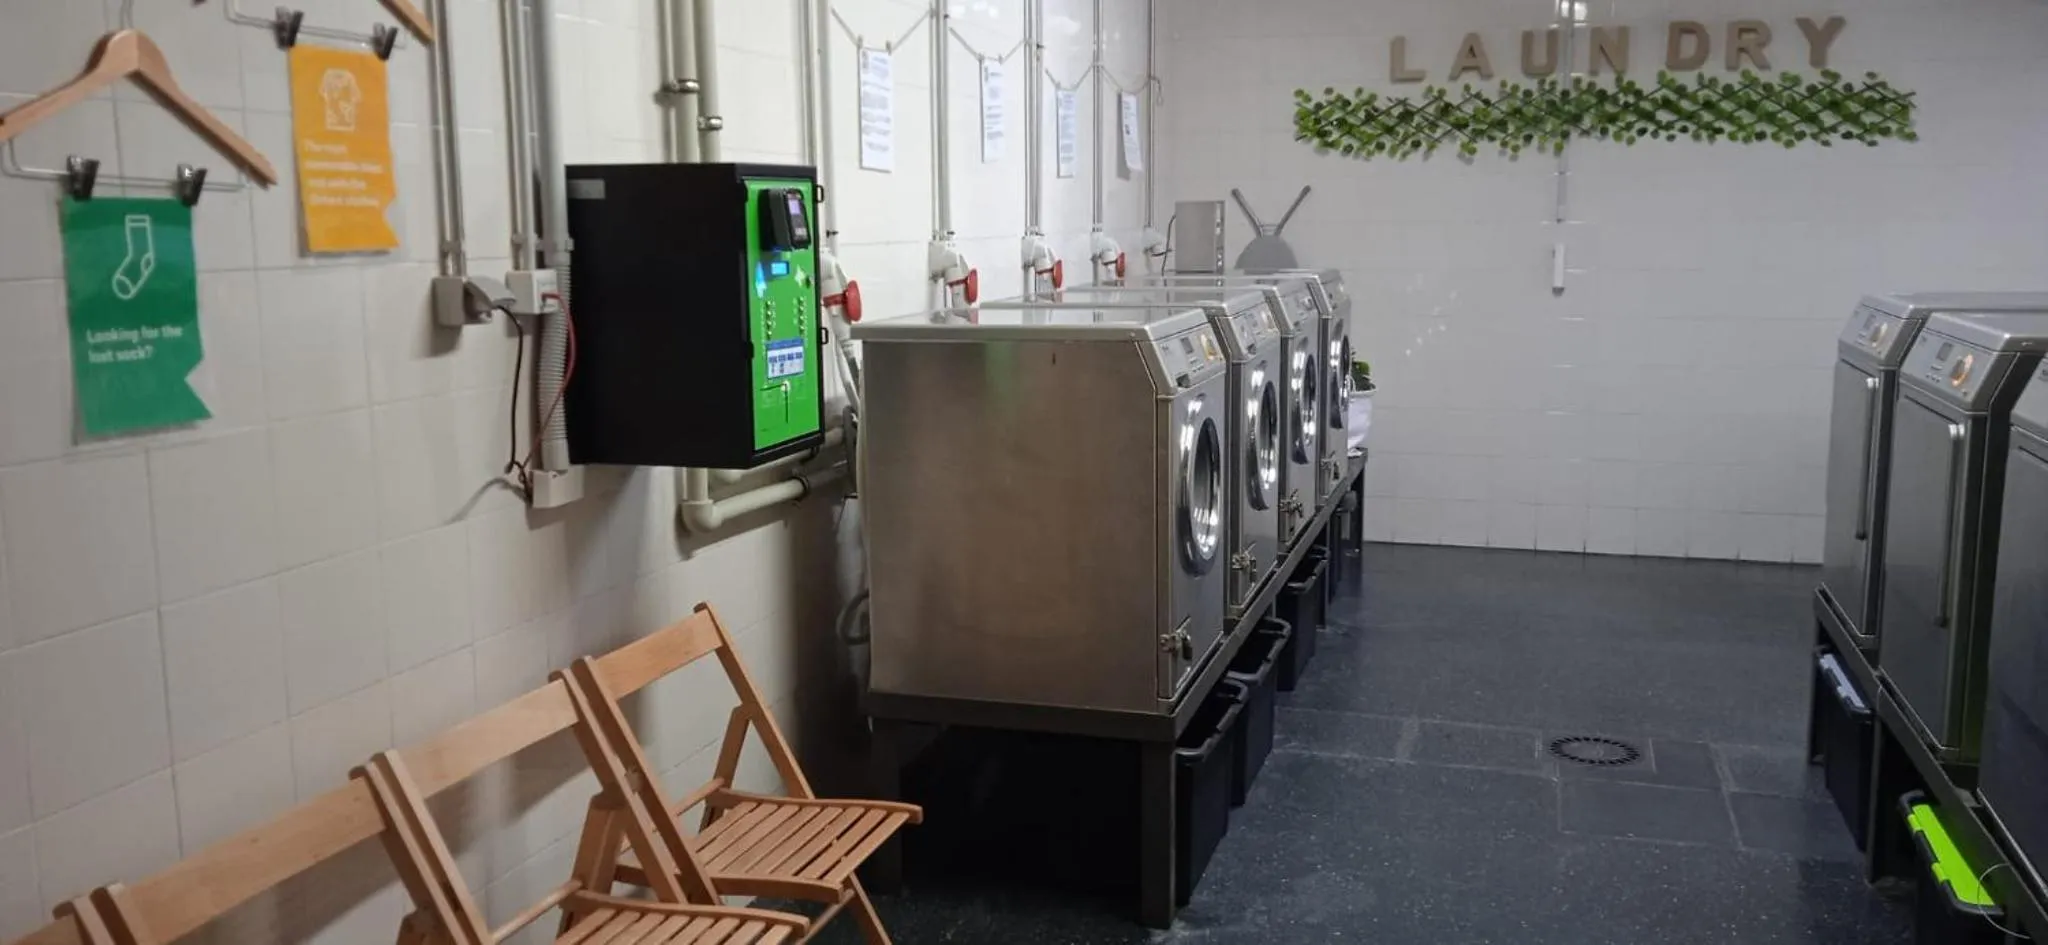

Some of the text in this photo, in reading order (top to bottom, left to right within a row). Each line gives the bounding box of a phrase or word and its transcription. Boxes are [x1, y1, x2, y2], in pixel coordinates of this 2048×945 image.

[1388, 15, 1848, 84] LAUNDRY
[86, 324, 183, 343] Looking for the
[116, 345, 153, 361] sock?
